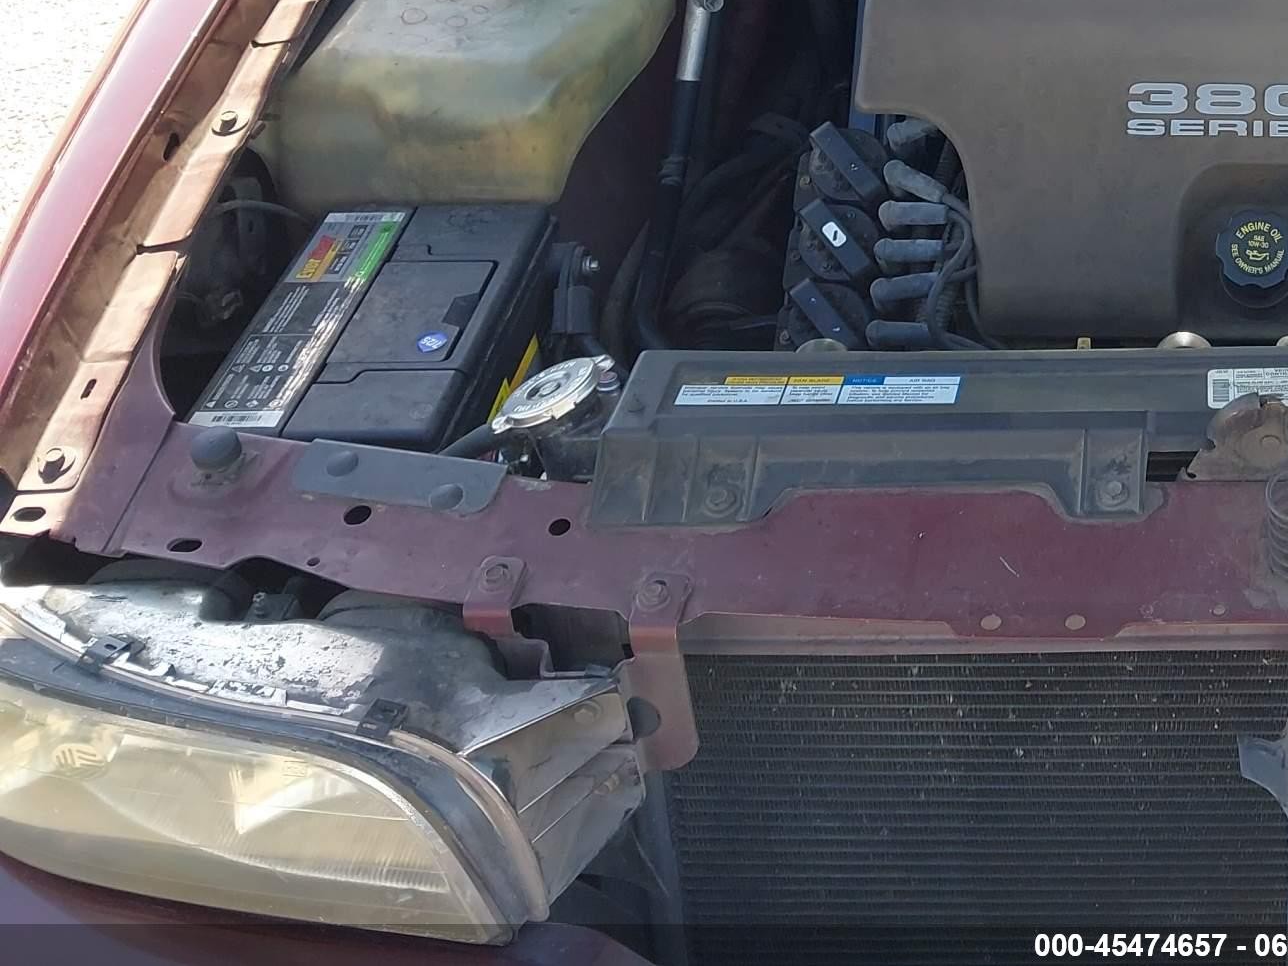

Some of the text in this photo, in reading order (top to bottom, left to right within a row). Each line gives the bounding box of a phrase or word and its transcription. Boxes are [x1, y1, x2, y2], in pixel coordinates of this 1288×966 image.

[1235, 222, 1283, 244] ENGINE OIL
[1248, 240, 1269, 249] 10W-30
[1231, 244, 1285, 275] SEE OWNER'S MANUAL
